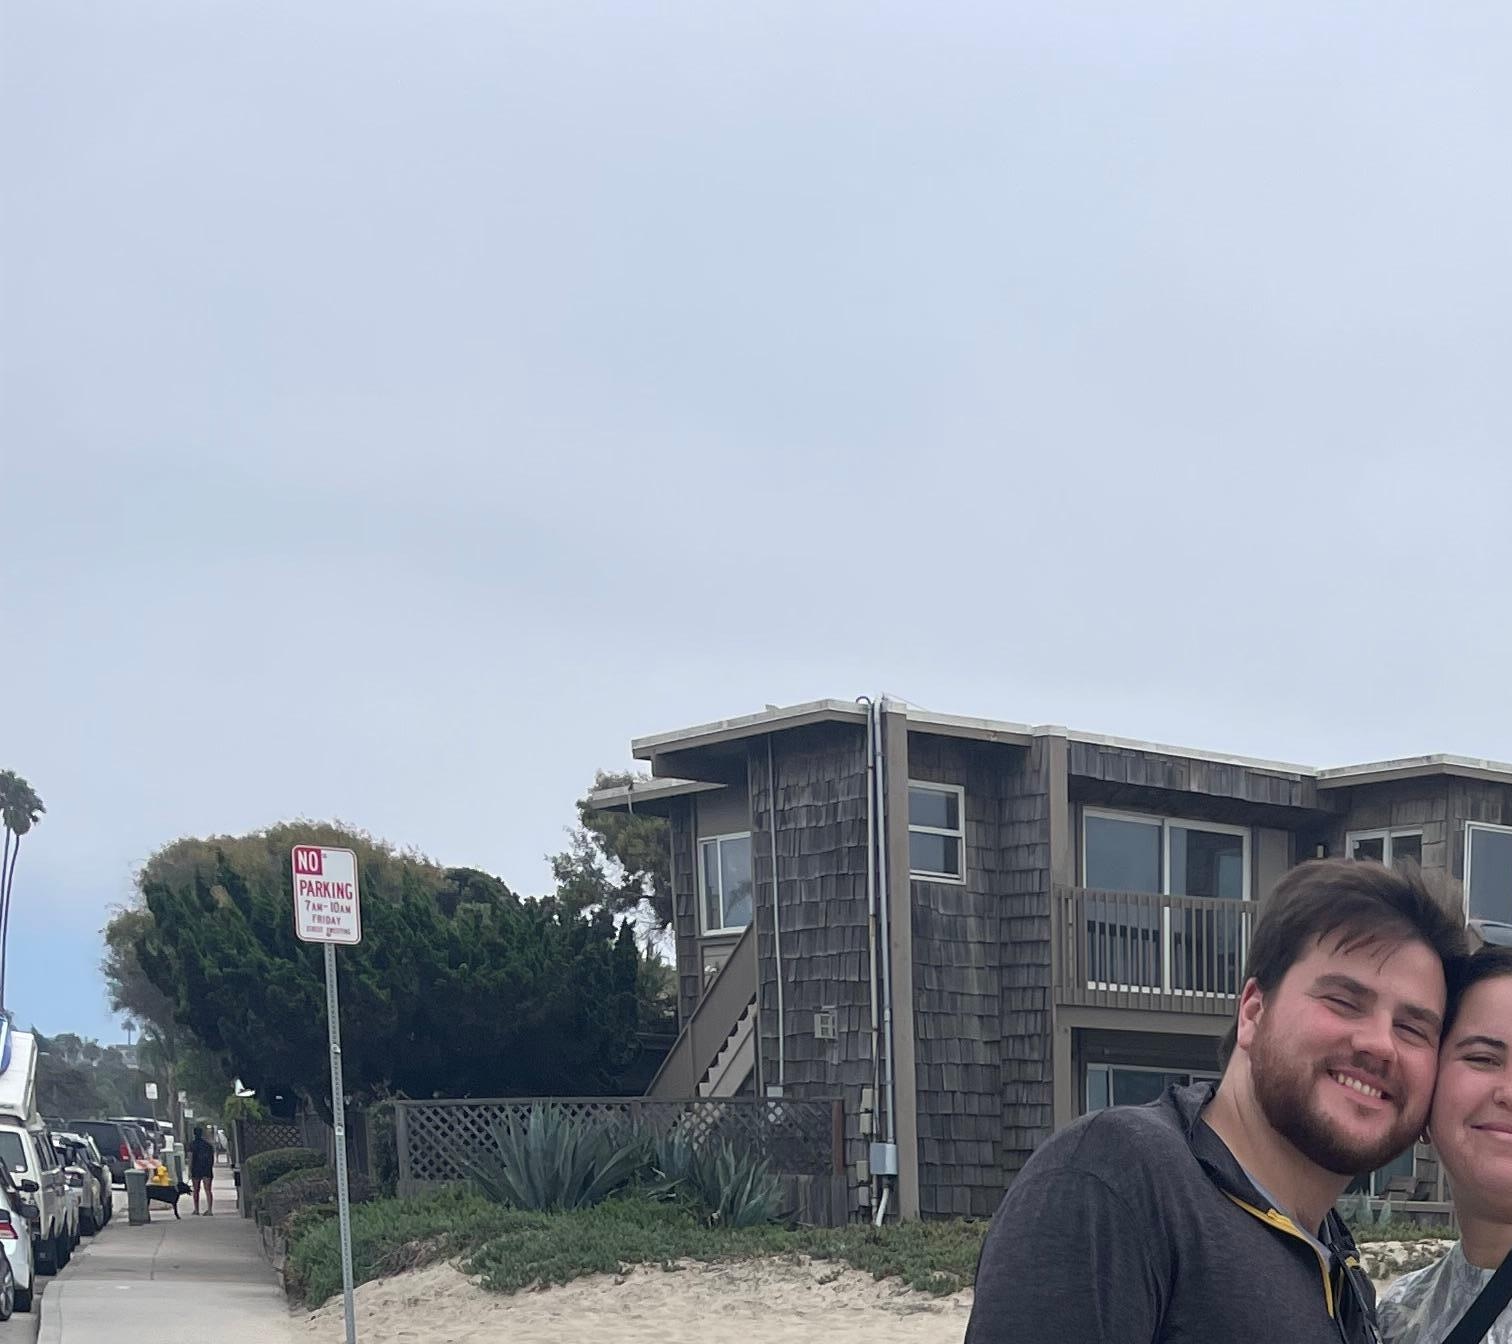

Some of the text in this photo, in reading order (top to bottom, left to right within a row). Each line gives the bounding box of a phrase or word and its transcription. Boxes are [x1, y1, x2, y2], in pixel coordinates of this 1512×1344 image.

[297, 850, 319, 872] NO
[299, 880, 353, 900] PARKING
[312, 914, 342, 925] FRIDAY
